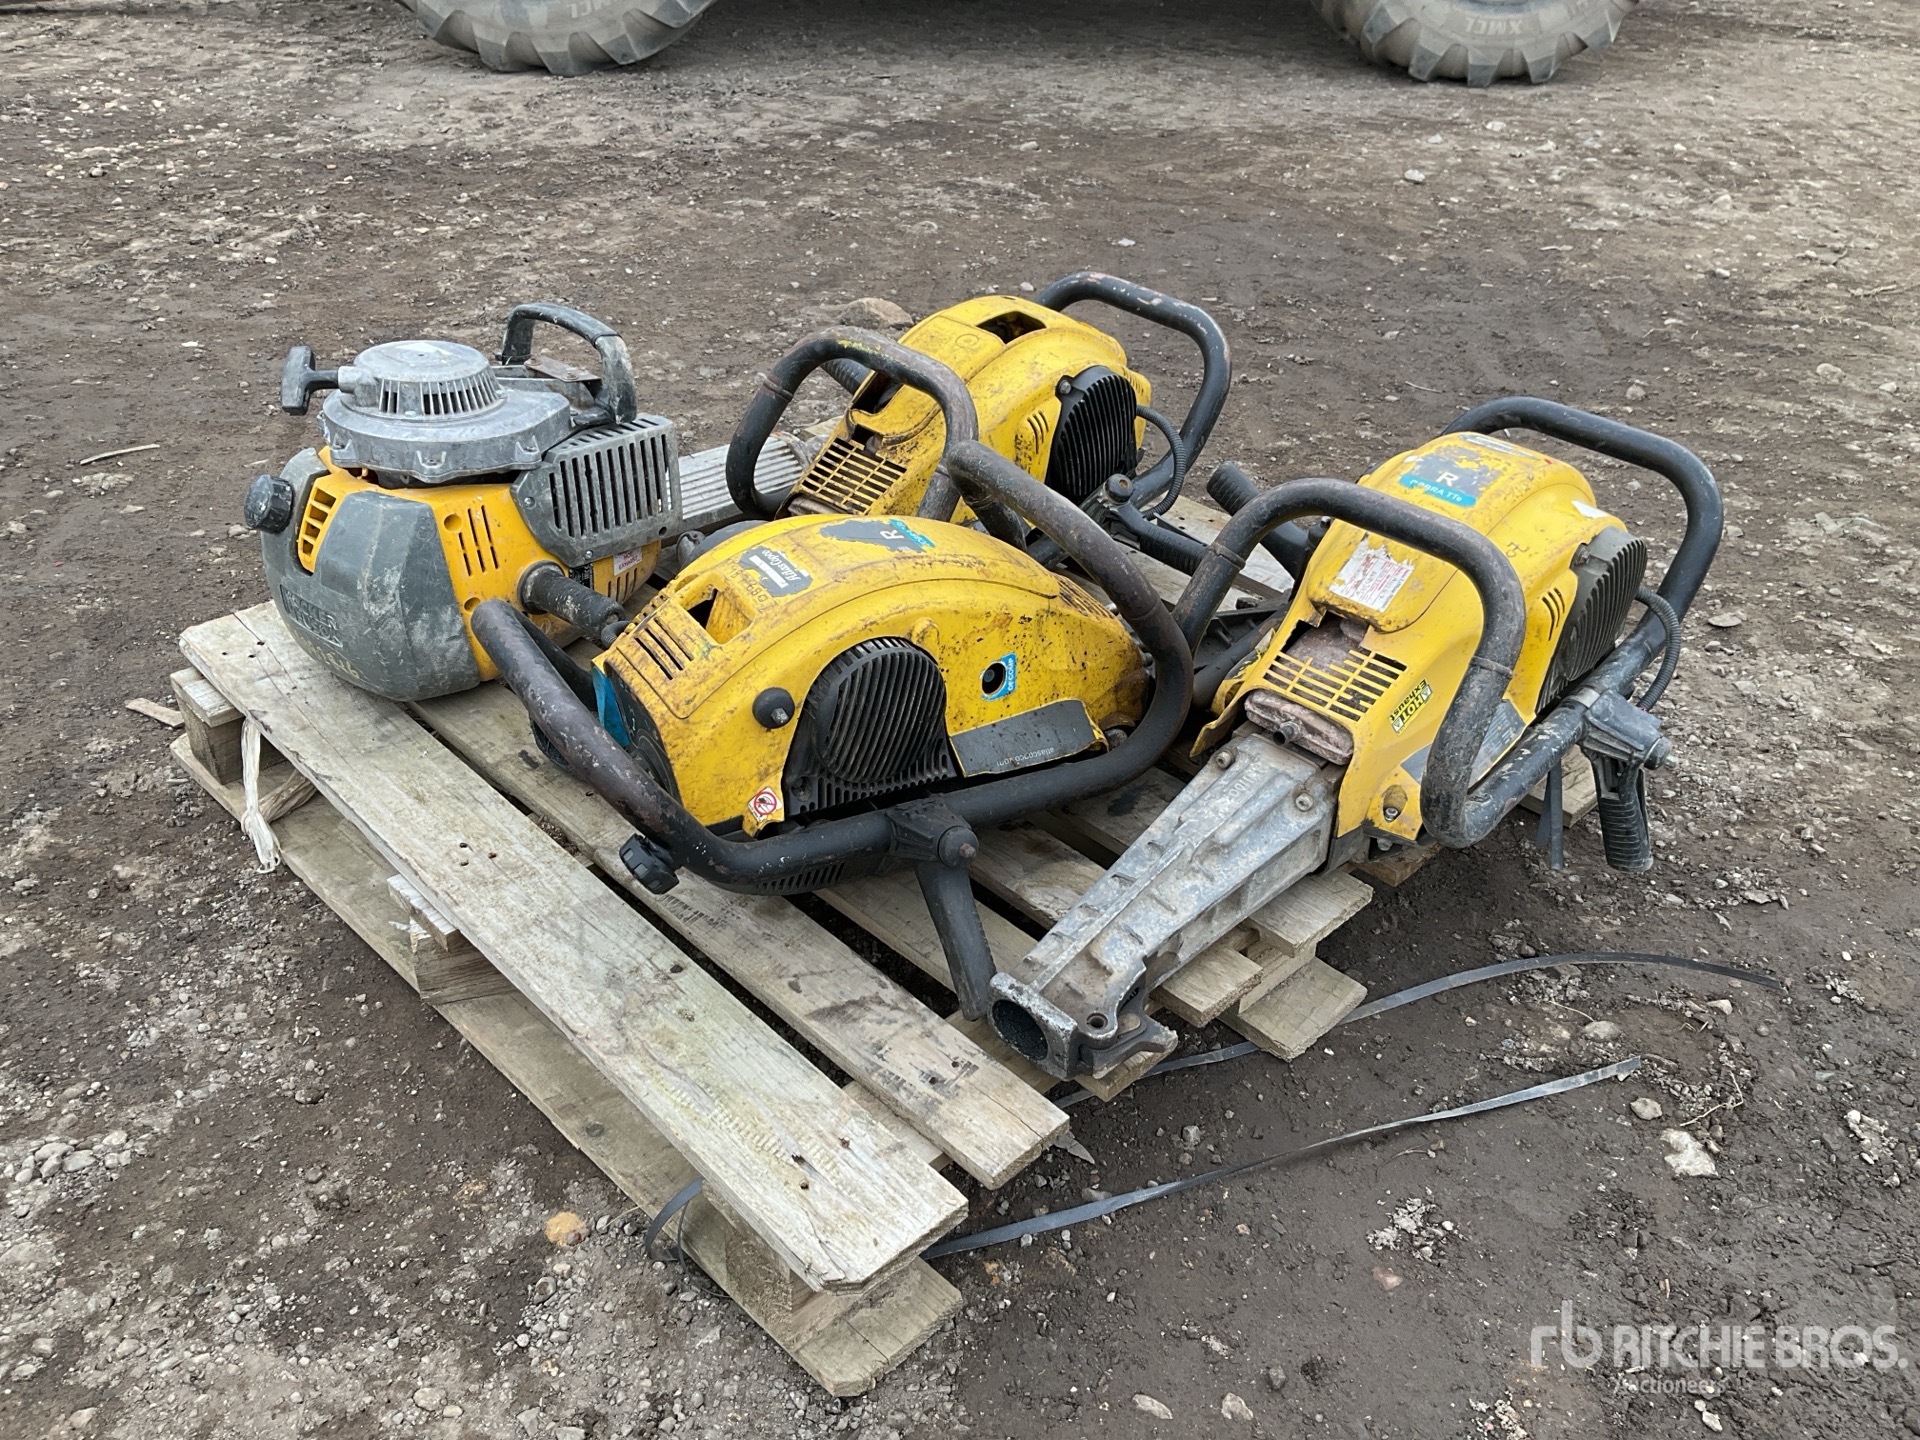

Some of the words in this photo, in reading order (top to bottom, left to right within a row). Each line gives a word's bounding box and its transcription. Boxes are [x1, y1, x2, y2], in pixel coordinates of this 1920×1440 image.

[1436, 471, 1459, 487] R
[879, 529, 905, 540] R
[761, 549, 783, 567] Copco
[778, 563, 802, 581] Atlas
[1389, 679, 1428, 721] Exhaust
[1399, 694, 1424, 722] HOT
